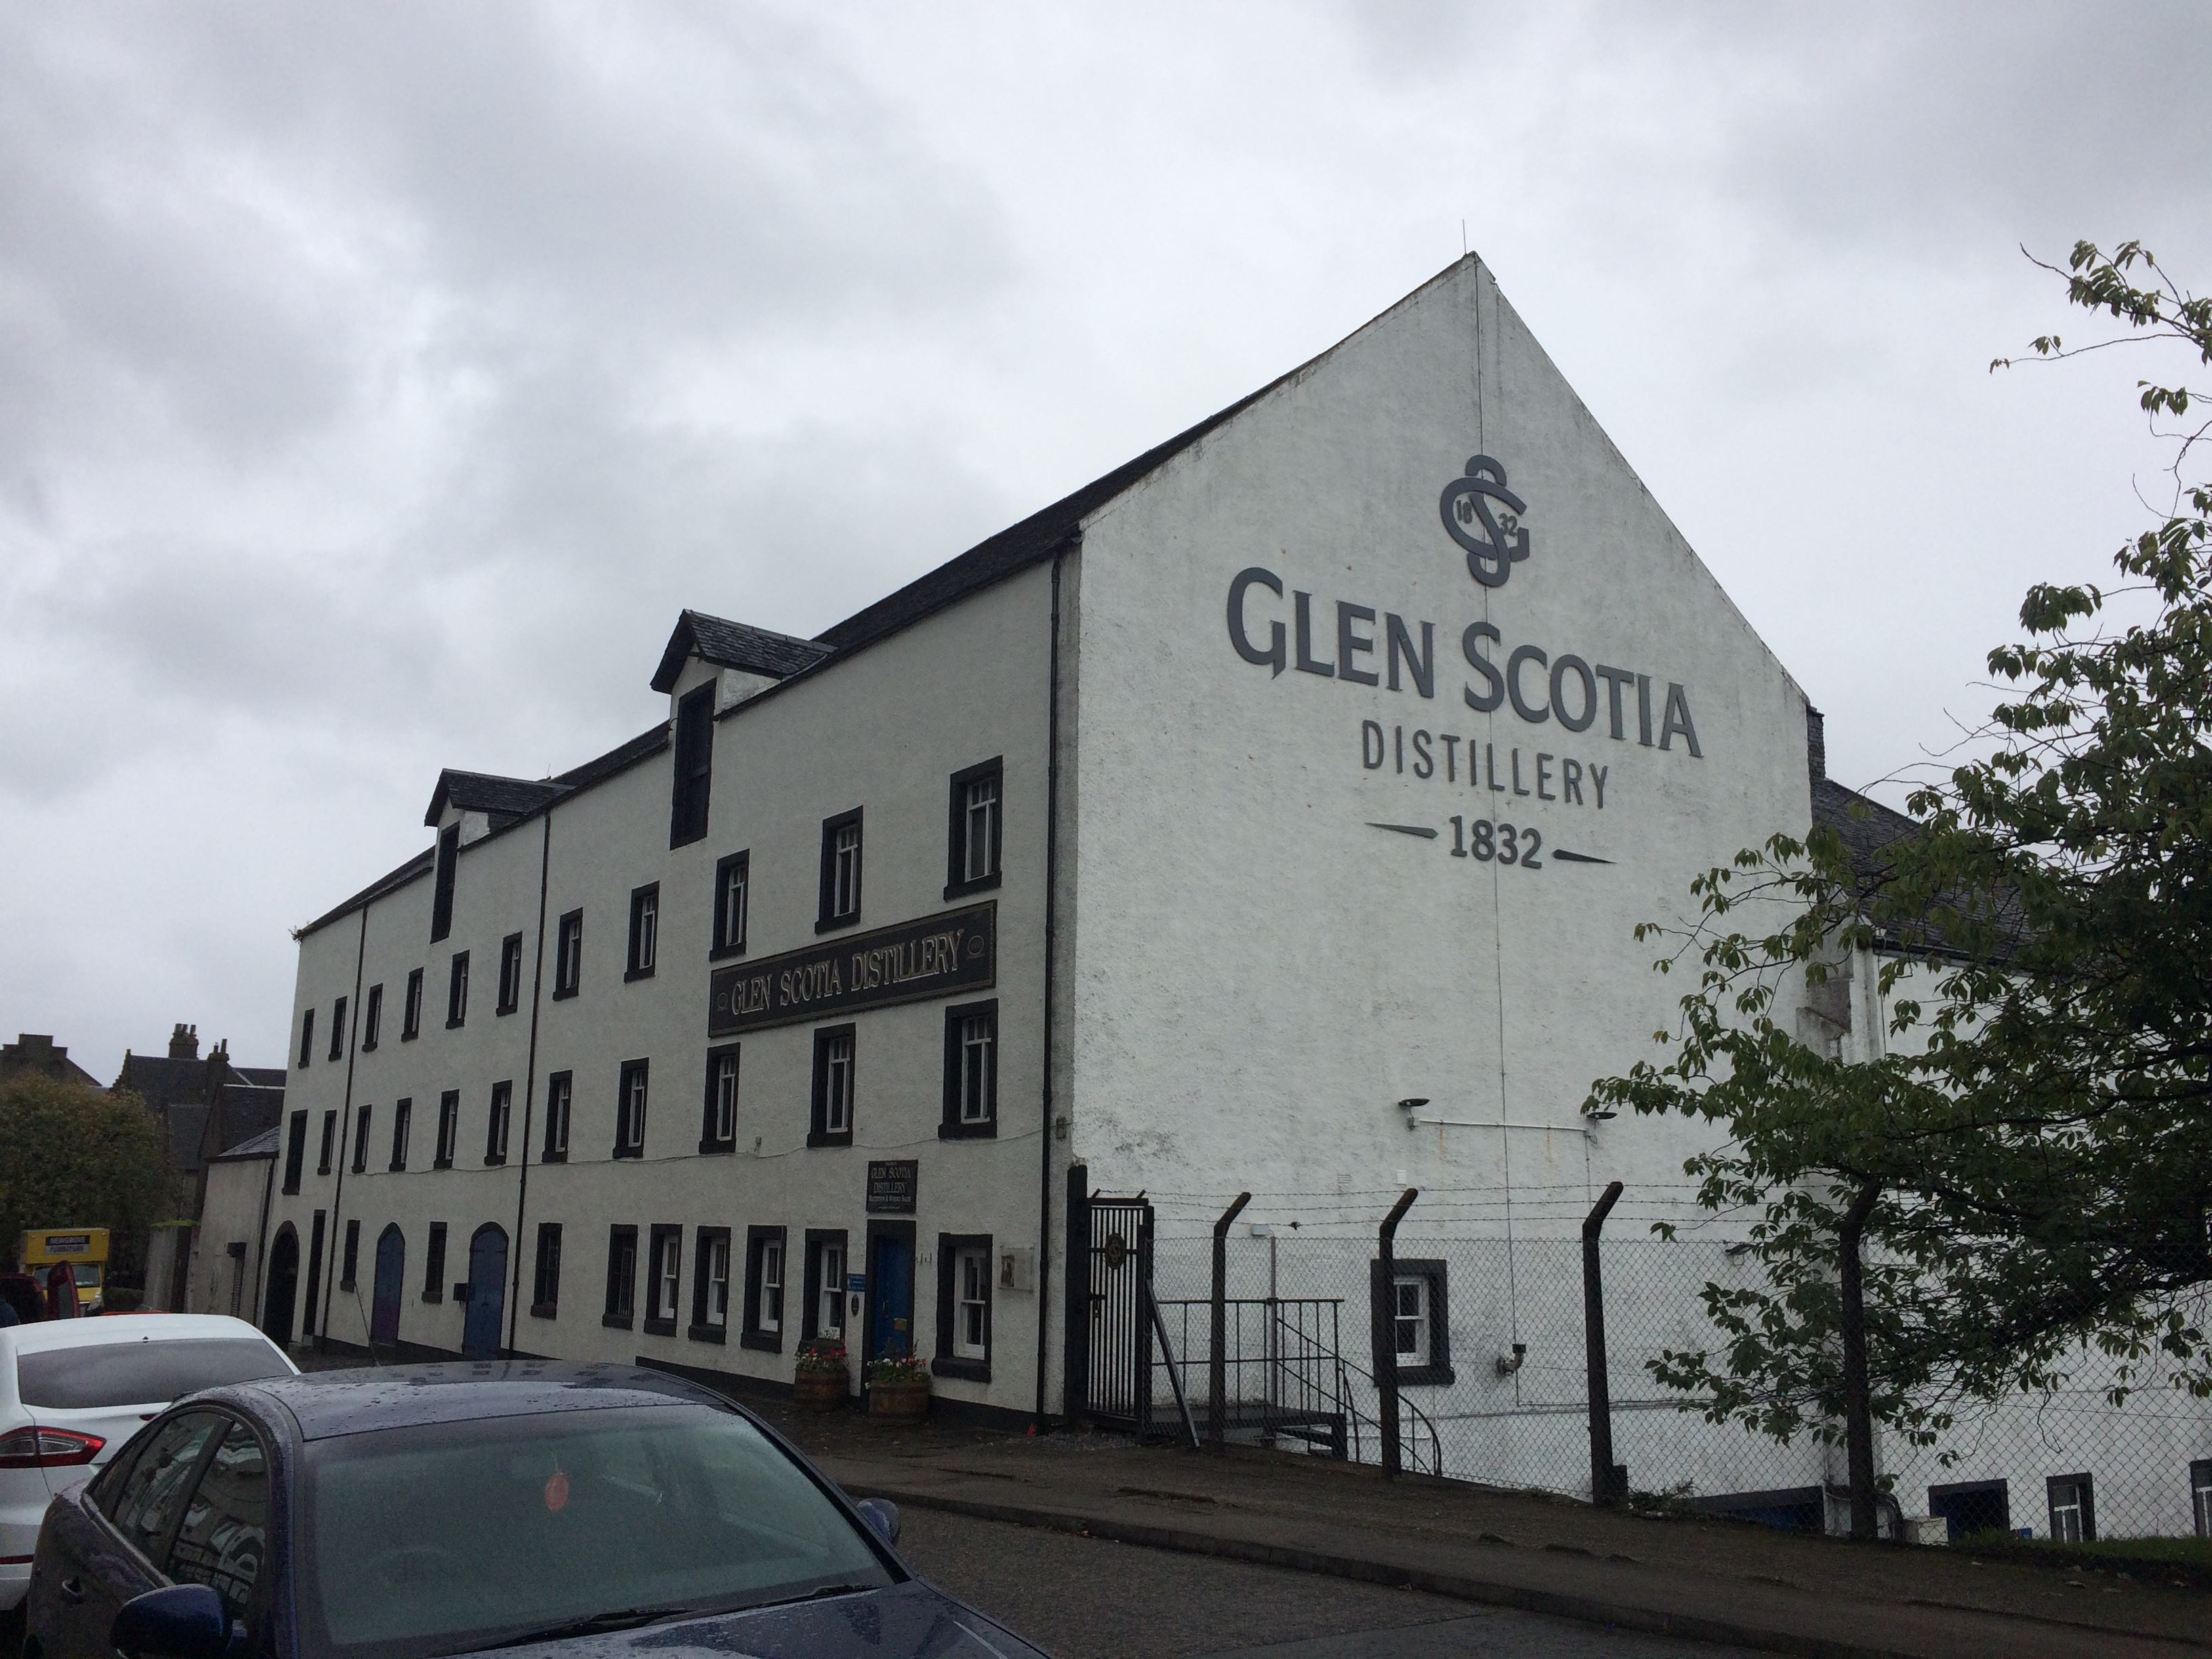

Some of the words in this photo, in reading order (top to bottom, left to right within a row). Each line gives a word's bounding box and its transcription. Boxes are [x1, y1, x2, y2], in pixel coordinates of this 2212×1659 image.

[1227, 567, 1435, 699] GLEN
[1462, 621, 1704, 758] SCOTIA
[1362, 719, 1608, 808] DISTILLERY
[1450, 815, 1543, 869] 1832
[731, 974, 772, 1015] GLEN
[780, 959, 842, 1006] SCOTIA
[852, 929, 964, 991] DISTILLERY
[871, 1167, 886, 1179] GLEN
[888, 1166, 911, 1179] SCOTIA
[874, 1182, 906, 1193] DISTILLERY
